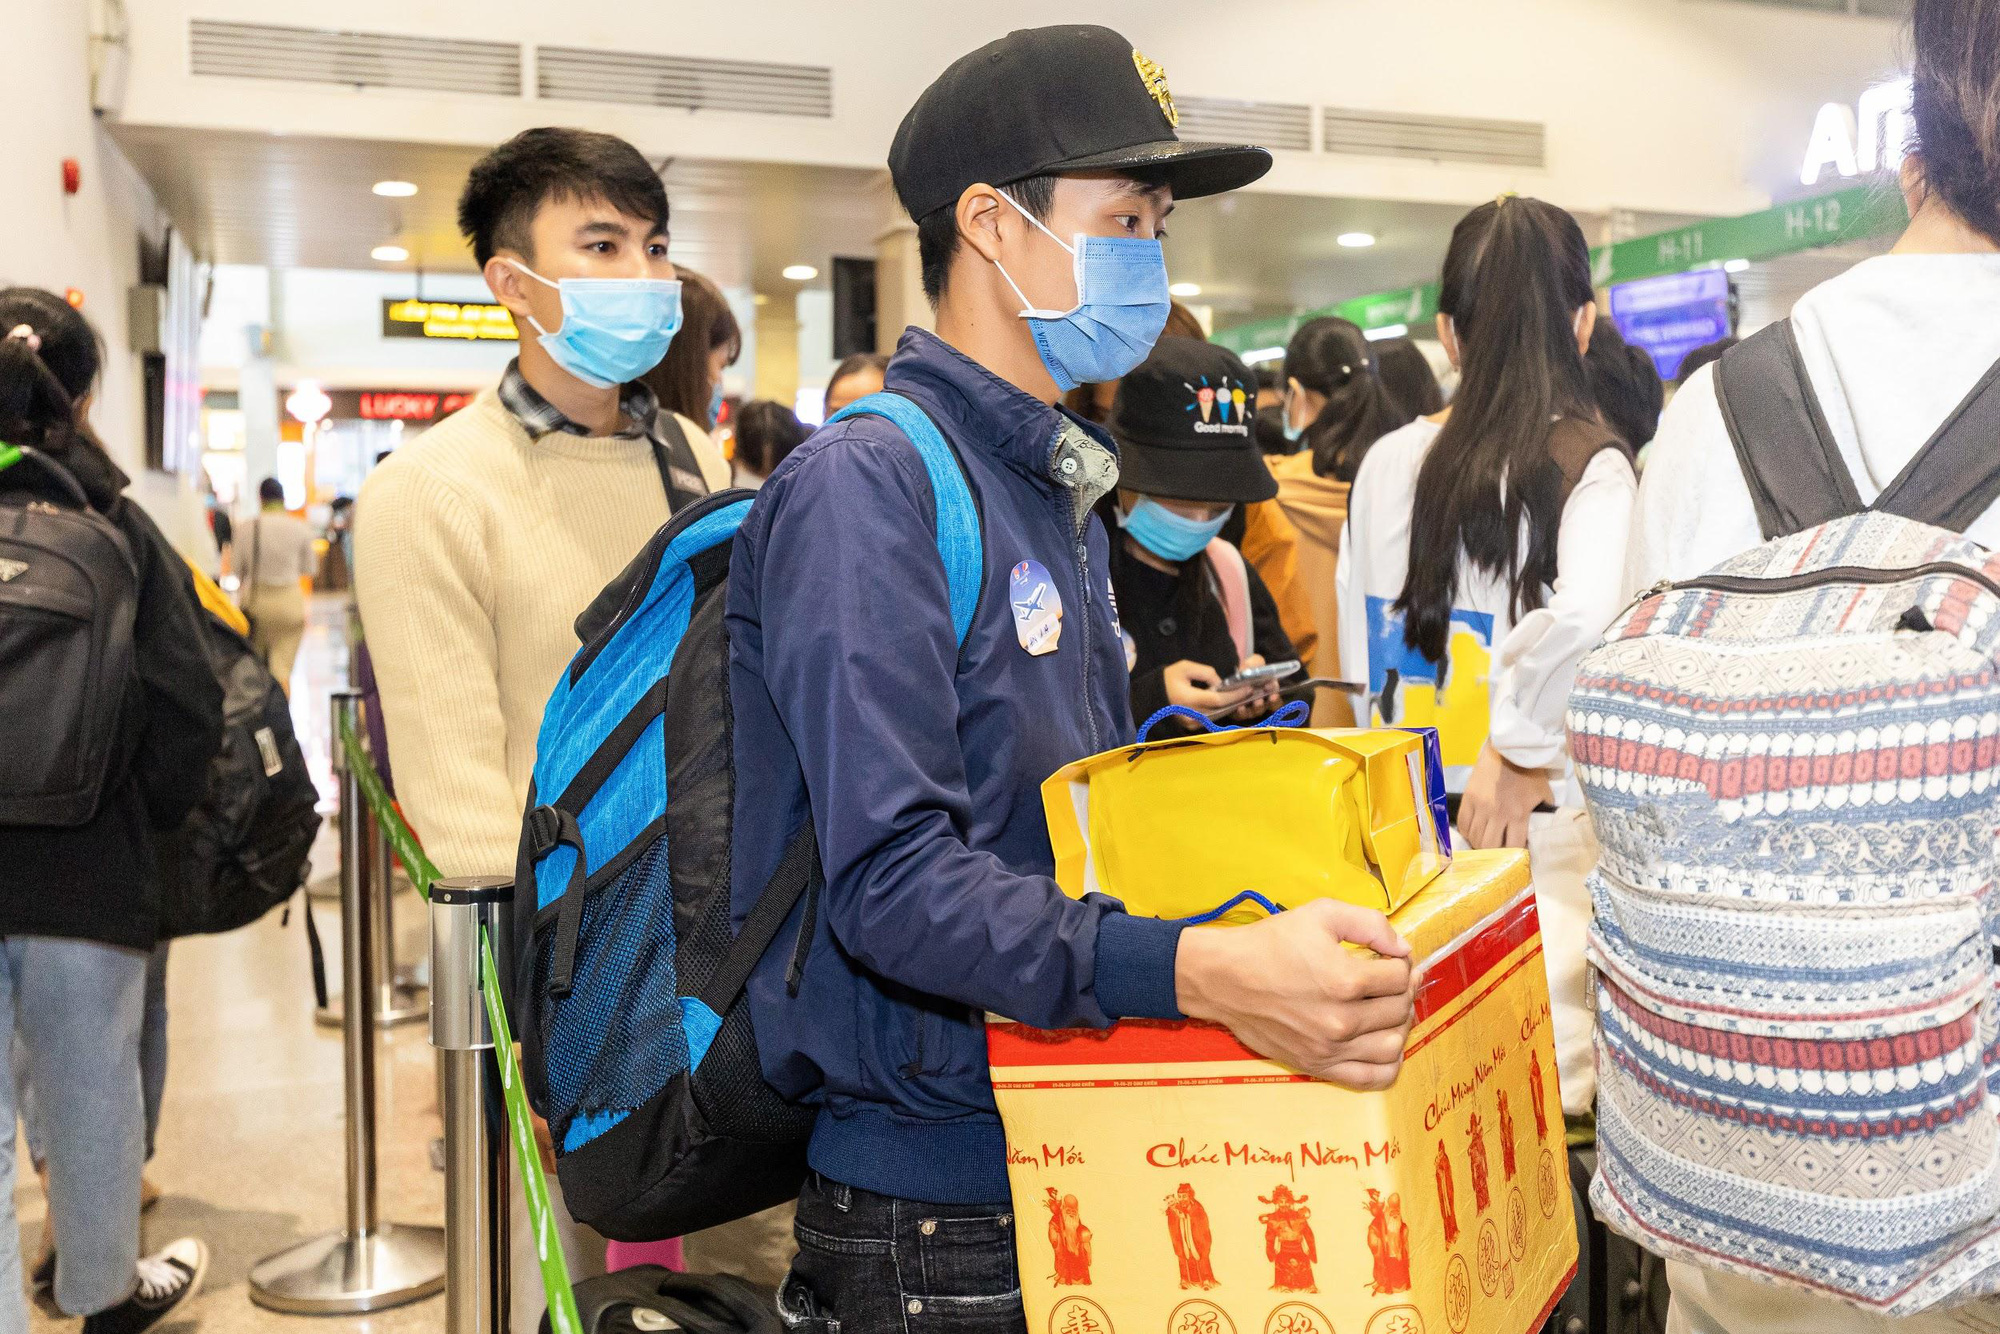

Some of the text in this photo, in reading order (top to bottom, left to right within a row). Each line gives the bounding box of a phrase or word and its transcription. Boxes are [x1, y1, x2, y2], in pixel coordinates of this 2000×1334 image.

[1784, 199, 1841, 239] H-12
[1658, 232, 1702, 261] H-11
[360, 392, 439, 420] LUCKY
[1193, 421, 1248, 438] Good morning
[1042, 1143, 1085, 1168] Mới
[1146, 1136, 1402, 1182] Chúc Mừng Năm Mới
